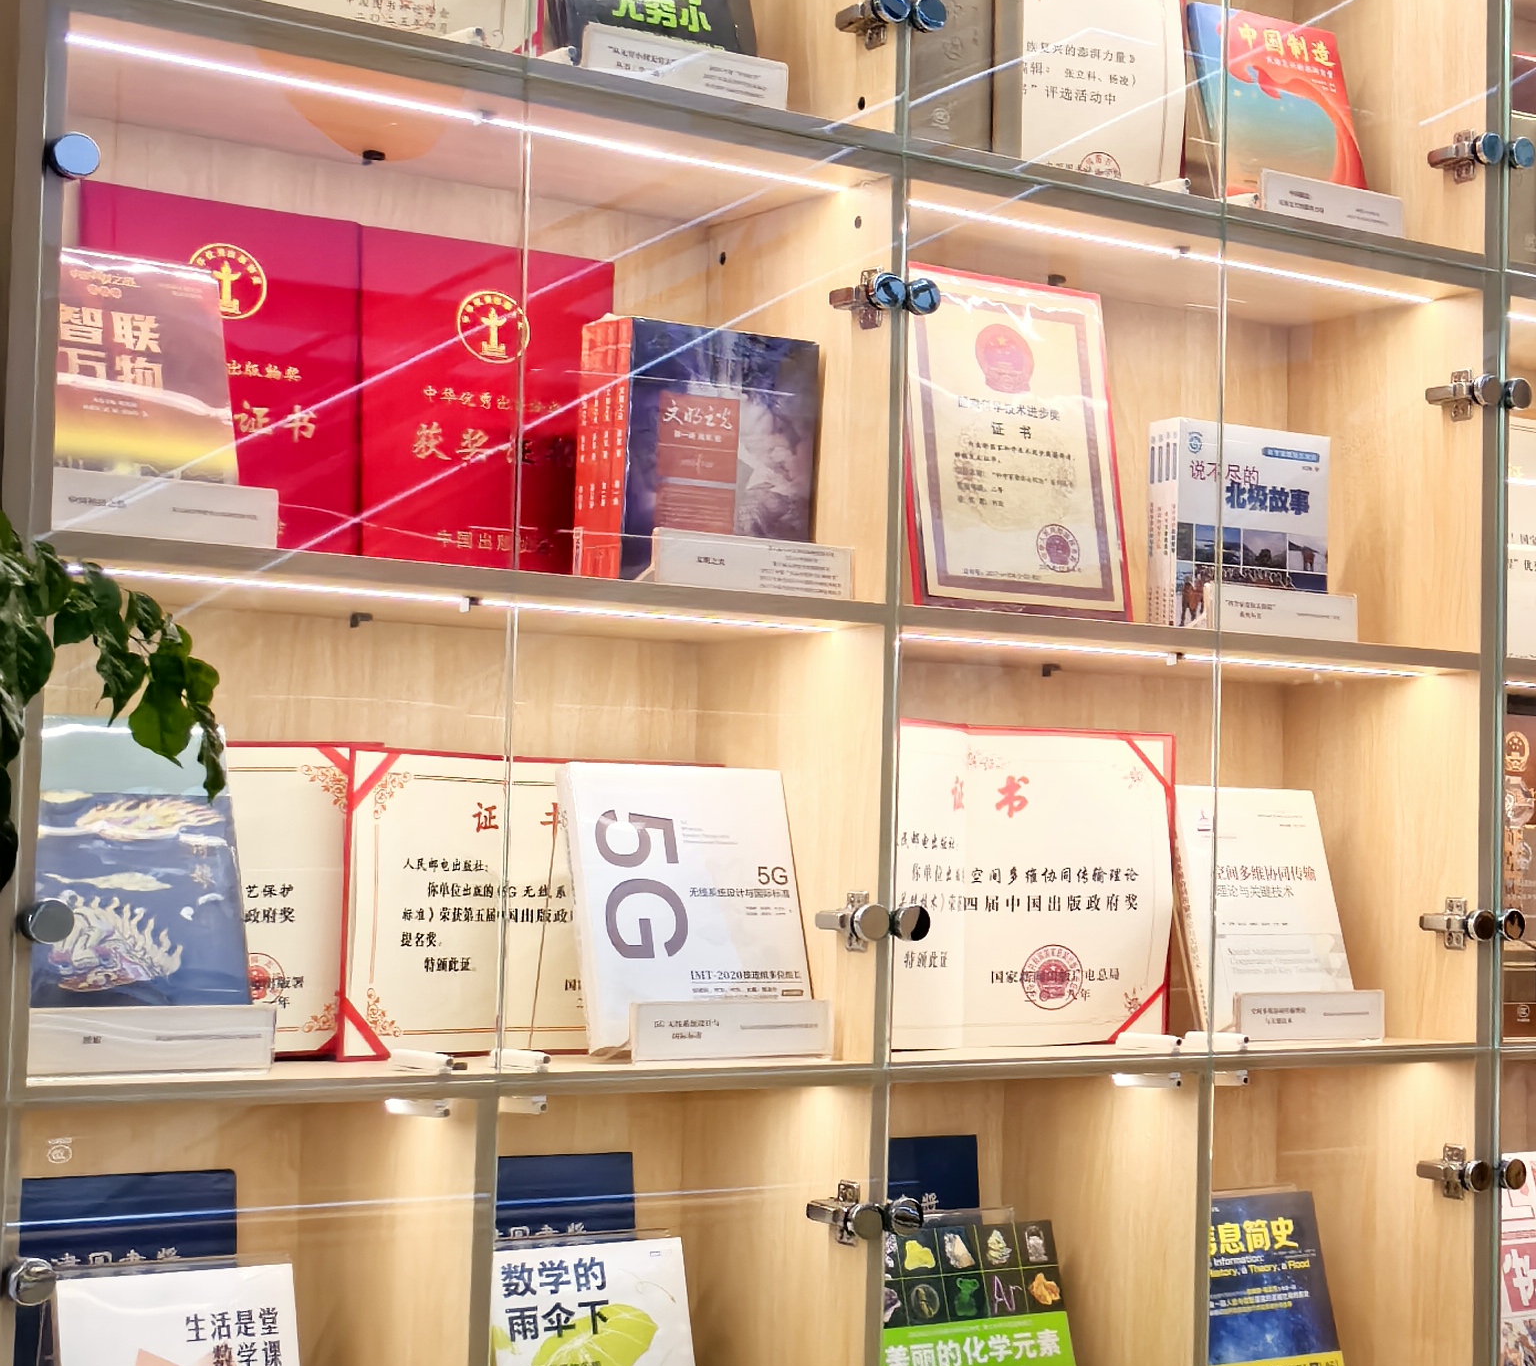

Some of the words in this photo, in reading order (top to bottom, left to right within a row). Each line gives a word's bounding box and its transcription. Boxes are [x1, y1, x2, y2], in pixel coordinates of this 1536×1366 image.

[1238, 21, 1336, 68] 中国制造
[60, 303, 161, 354] 智联
[58, 346, 164, 392] 万物
[232, 399, 318, 443] 证书
[991, 421, 1032, 440] 证书
[1189, 460, 1259, 486] 说不尽的
[1225, 482, 1310, 515] 北极故事
[595, 809, 688, 959] 5G
[689, 886, 791, 899] 无线系统设计与国际标准
[757, 866, 789, 885] 5G
[1216, 884, 1294, 899] 理论与关键技术
[500, 1256, 607, 1299] 数学的
[185, 1306, 279, 1343] 生活是堂
[505, 1299, 610, 1342] 雨伞下
